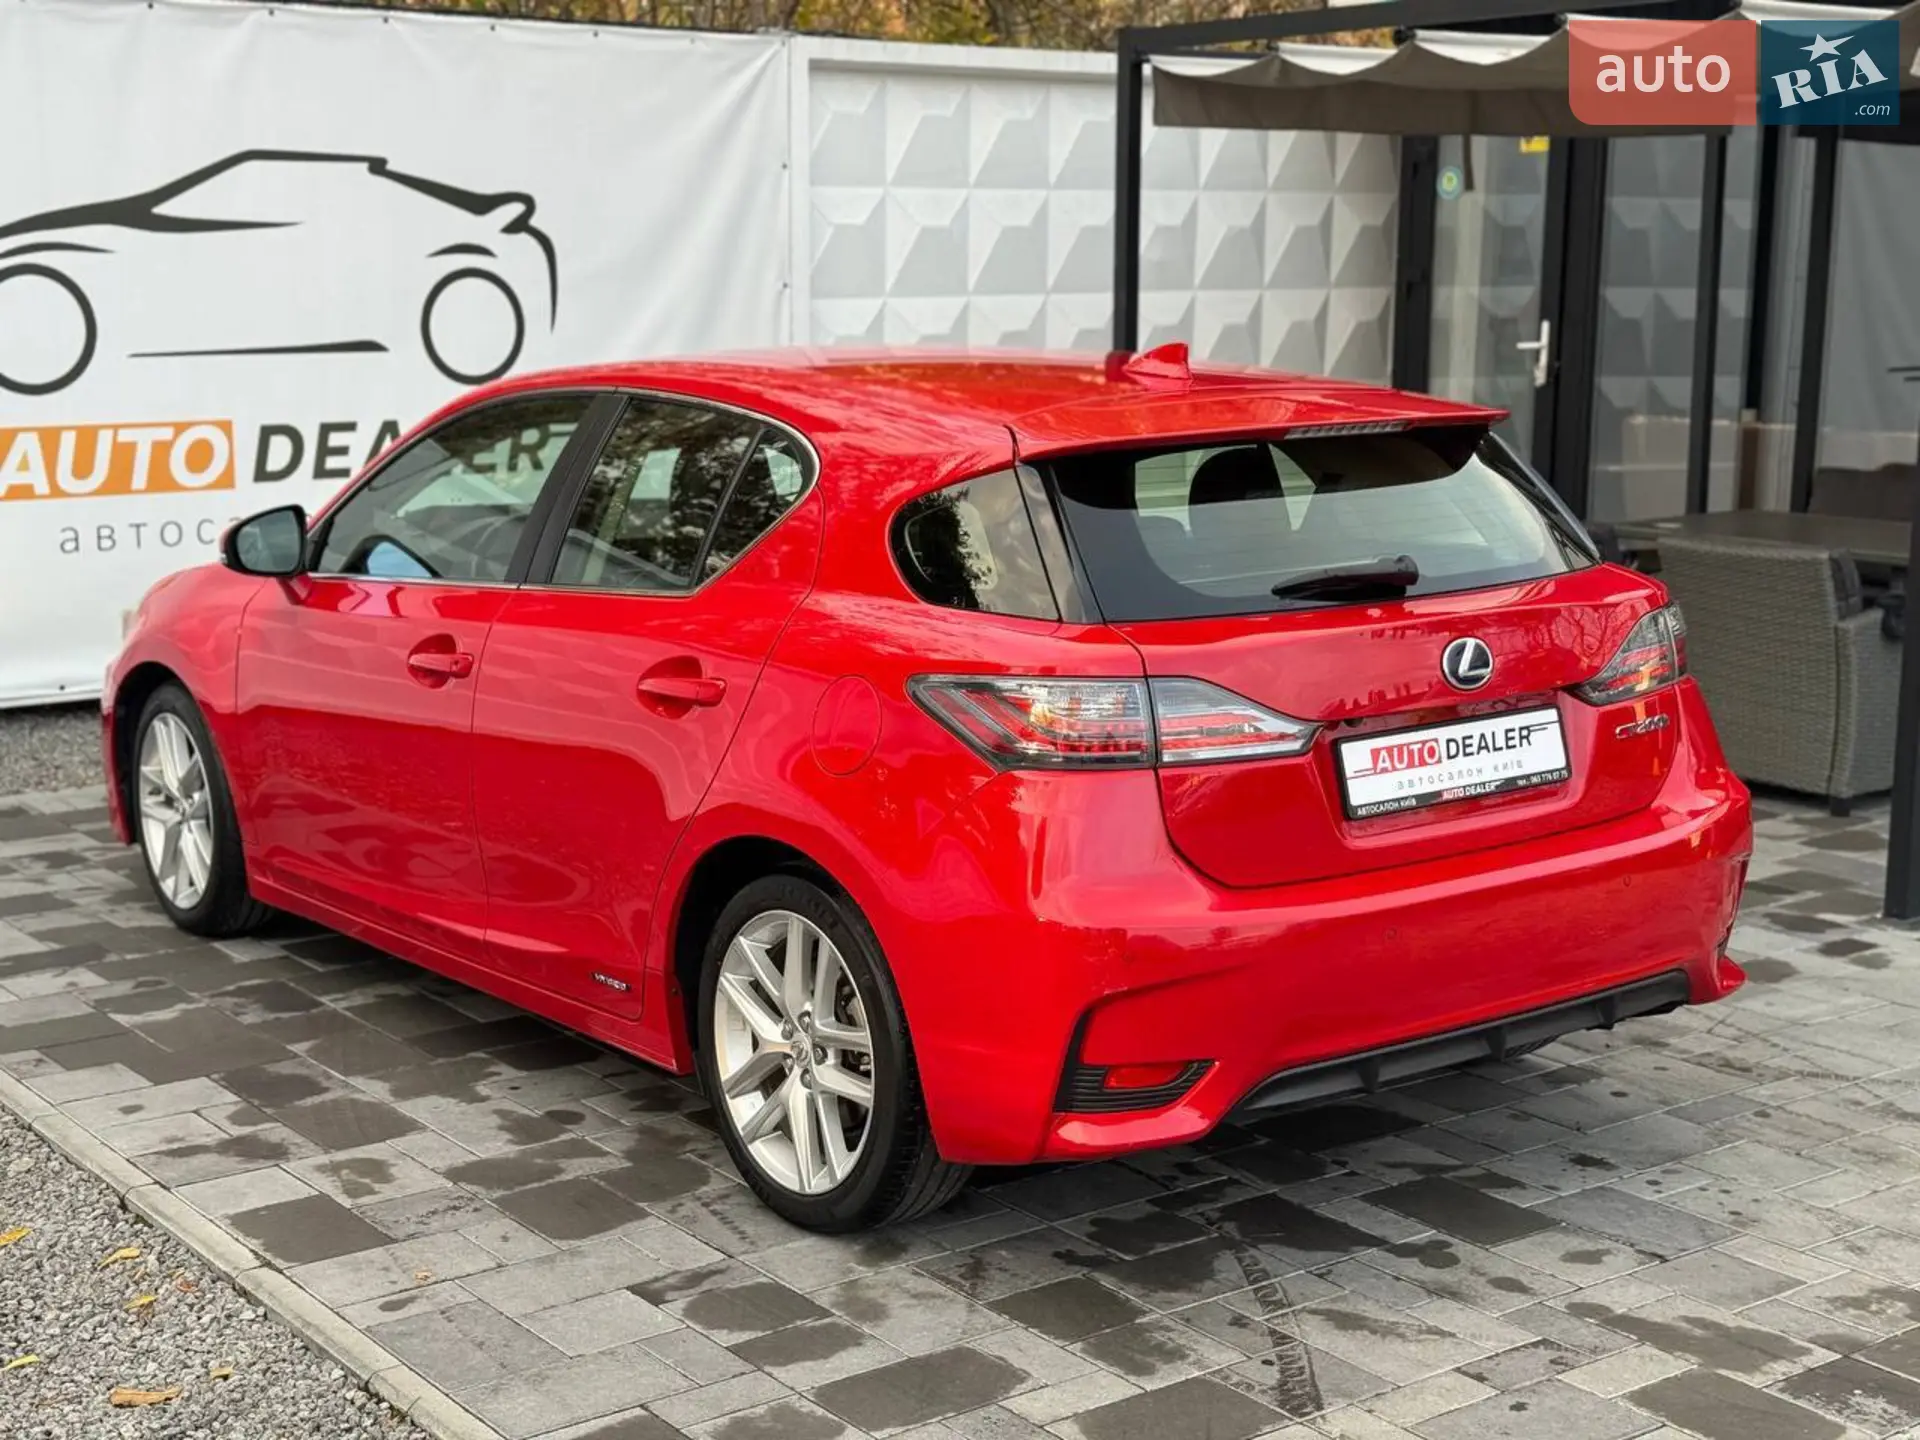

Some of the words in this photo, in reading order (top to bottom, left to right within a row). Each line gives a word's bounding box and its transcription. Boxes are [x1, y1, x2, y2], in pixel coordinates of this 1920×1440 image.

[0, 423, 231, 498] AUTO
[1375, 740, 1440, 773] AUTO
[1445, 726, 1532, 760] DEALER
[1397, 768, 1484, 790] автосалон
[1442, 788, 1465, 800] AUTO
[1465, 782, 1496, 796] DEALER
